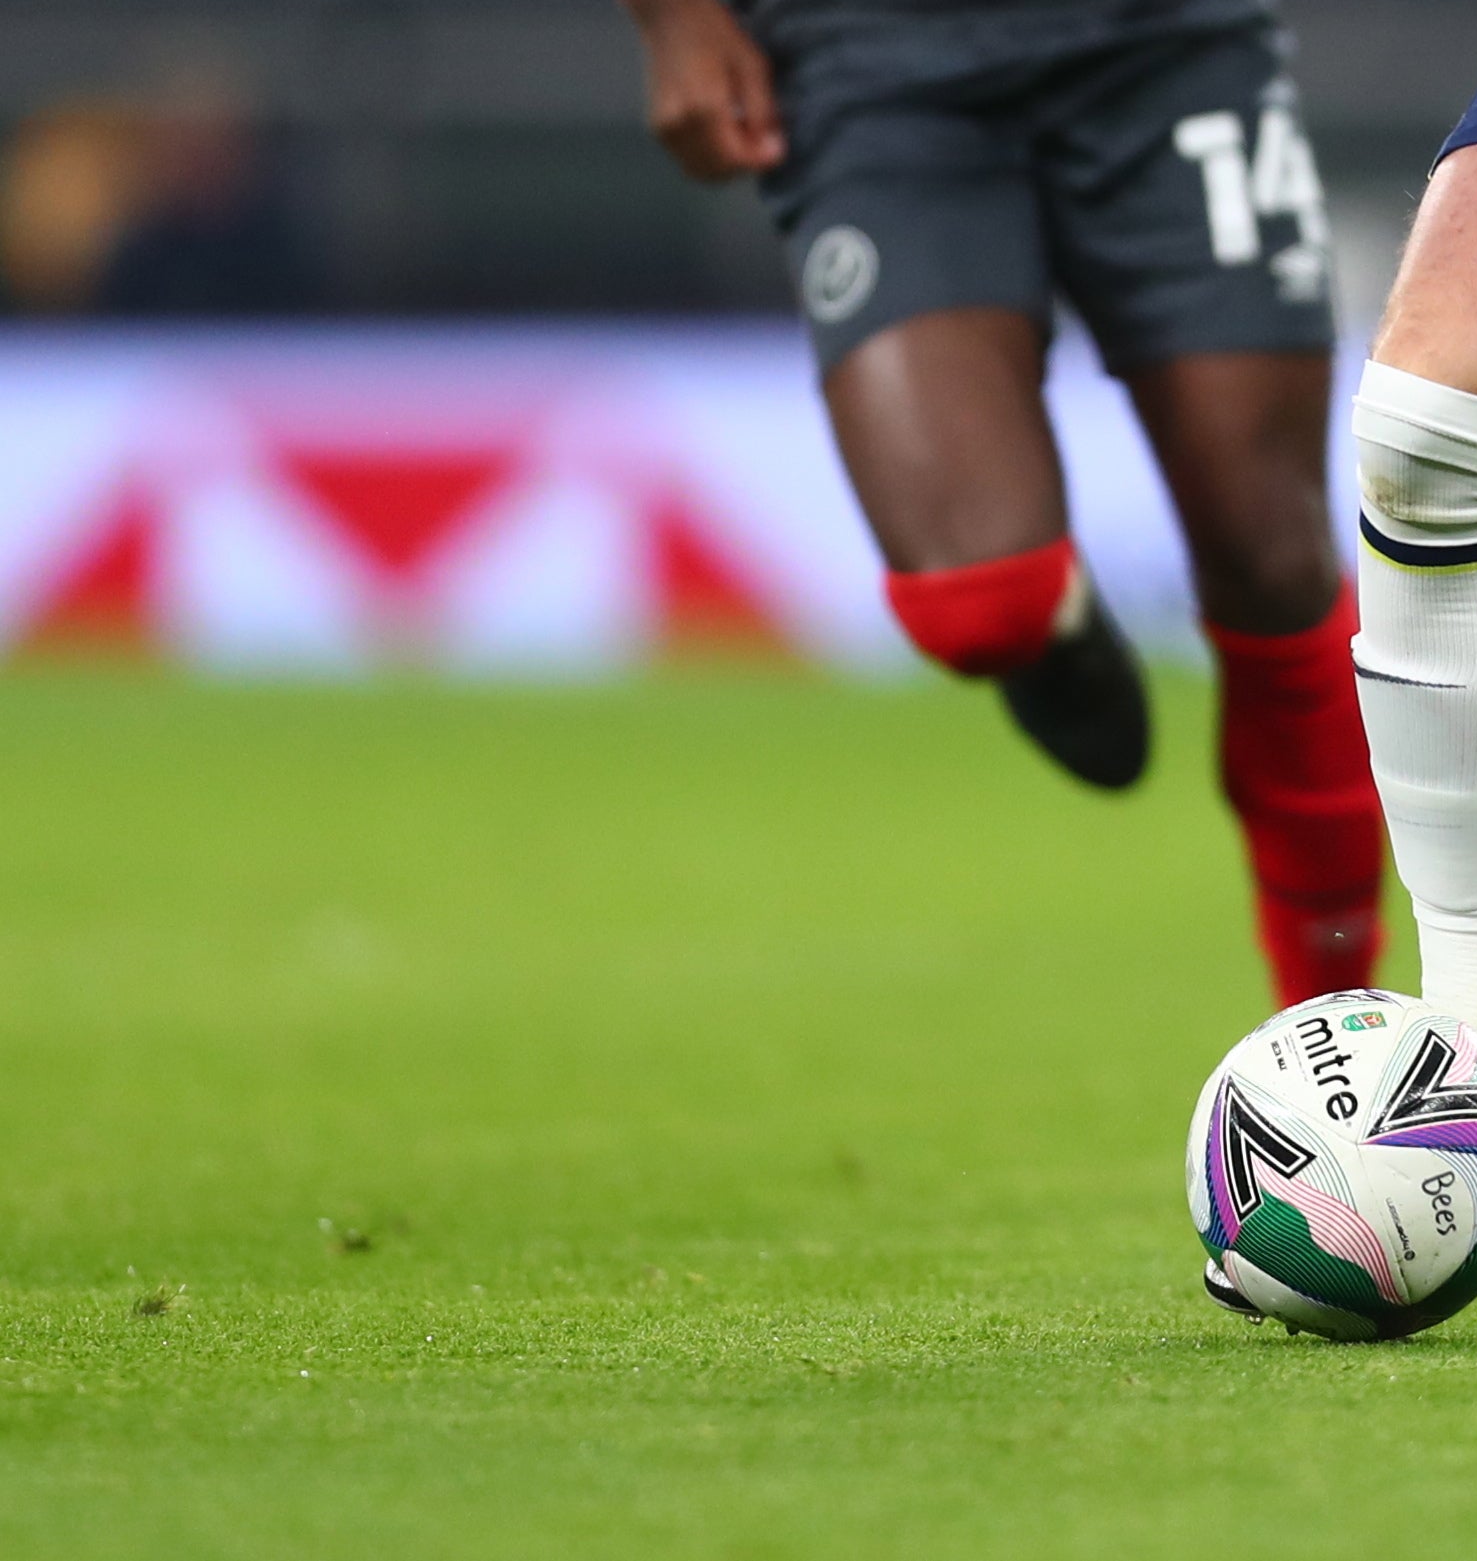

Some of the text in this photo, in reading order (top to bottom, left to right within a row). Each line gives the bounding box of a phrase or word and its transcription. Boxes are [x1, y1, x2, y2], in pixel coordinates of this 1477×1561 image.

[1173, 110, 1330, 265] 14
[1296, 1017, 1359, 1120] mitre
[1421, 1171, 1457, 1236] Bees
